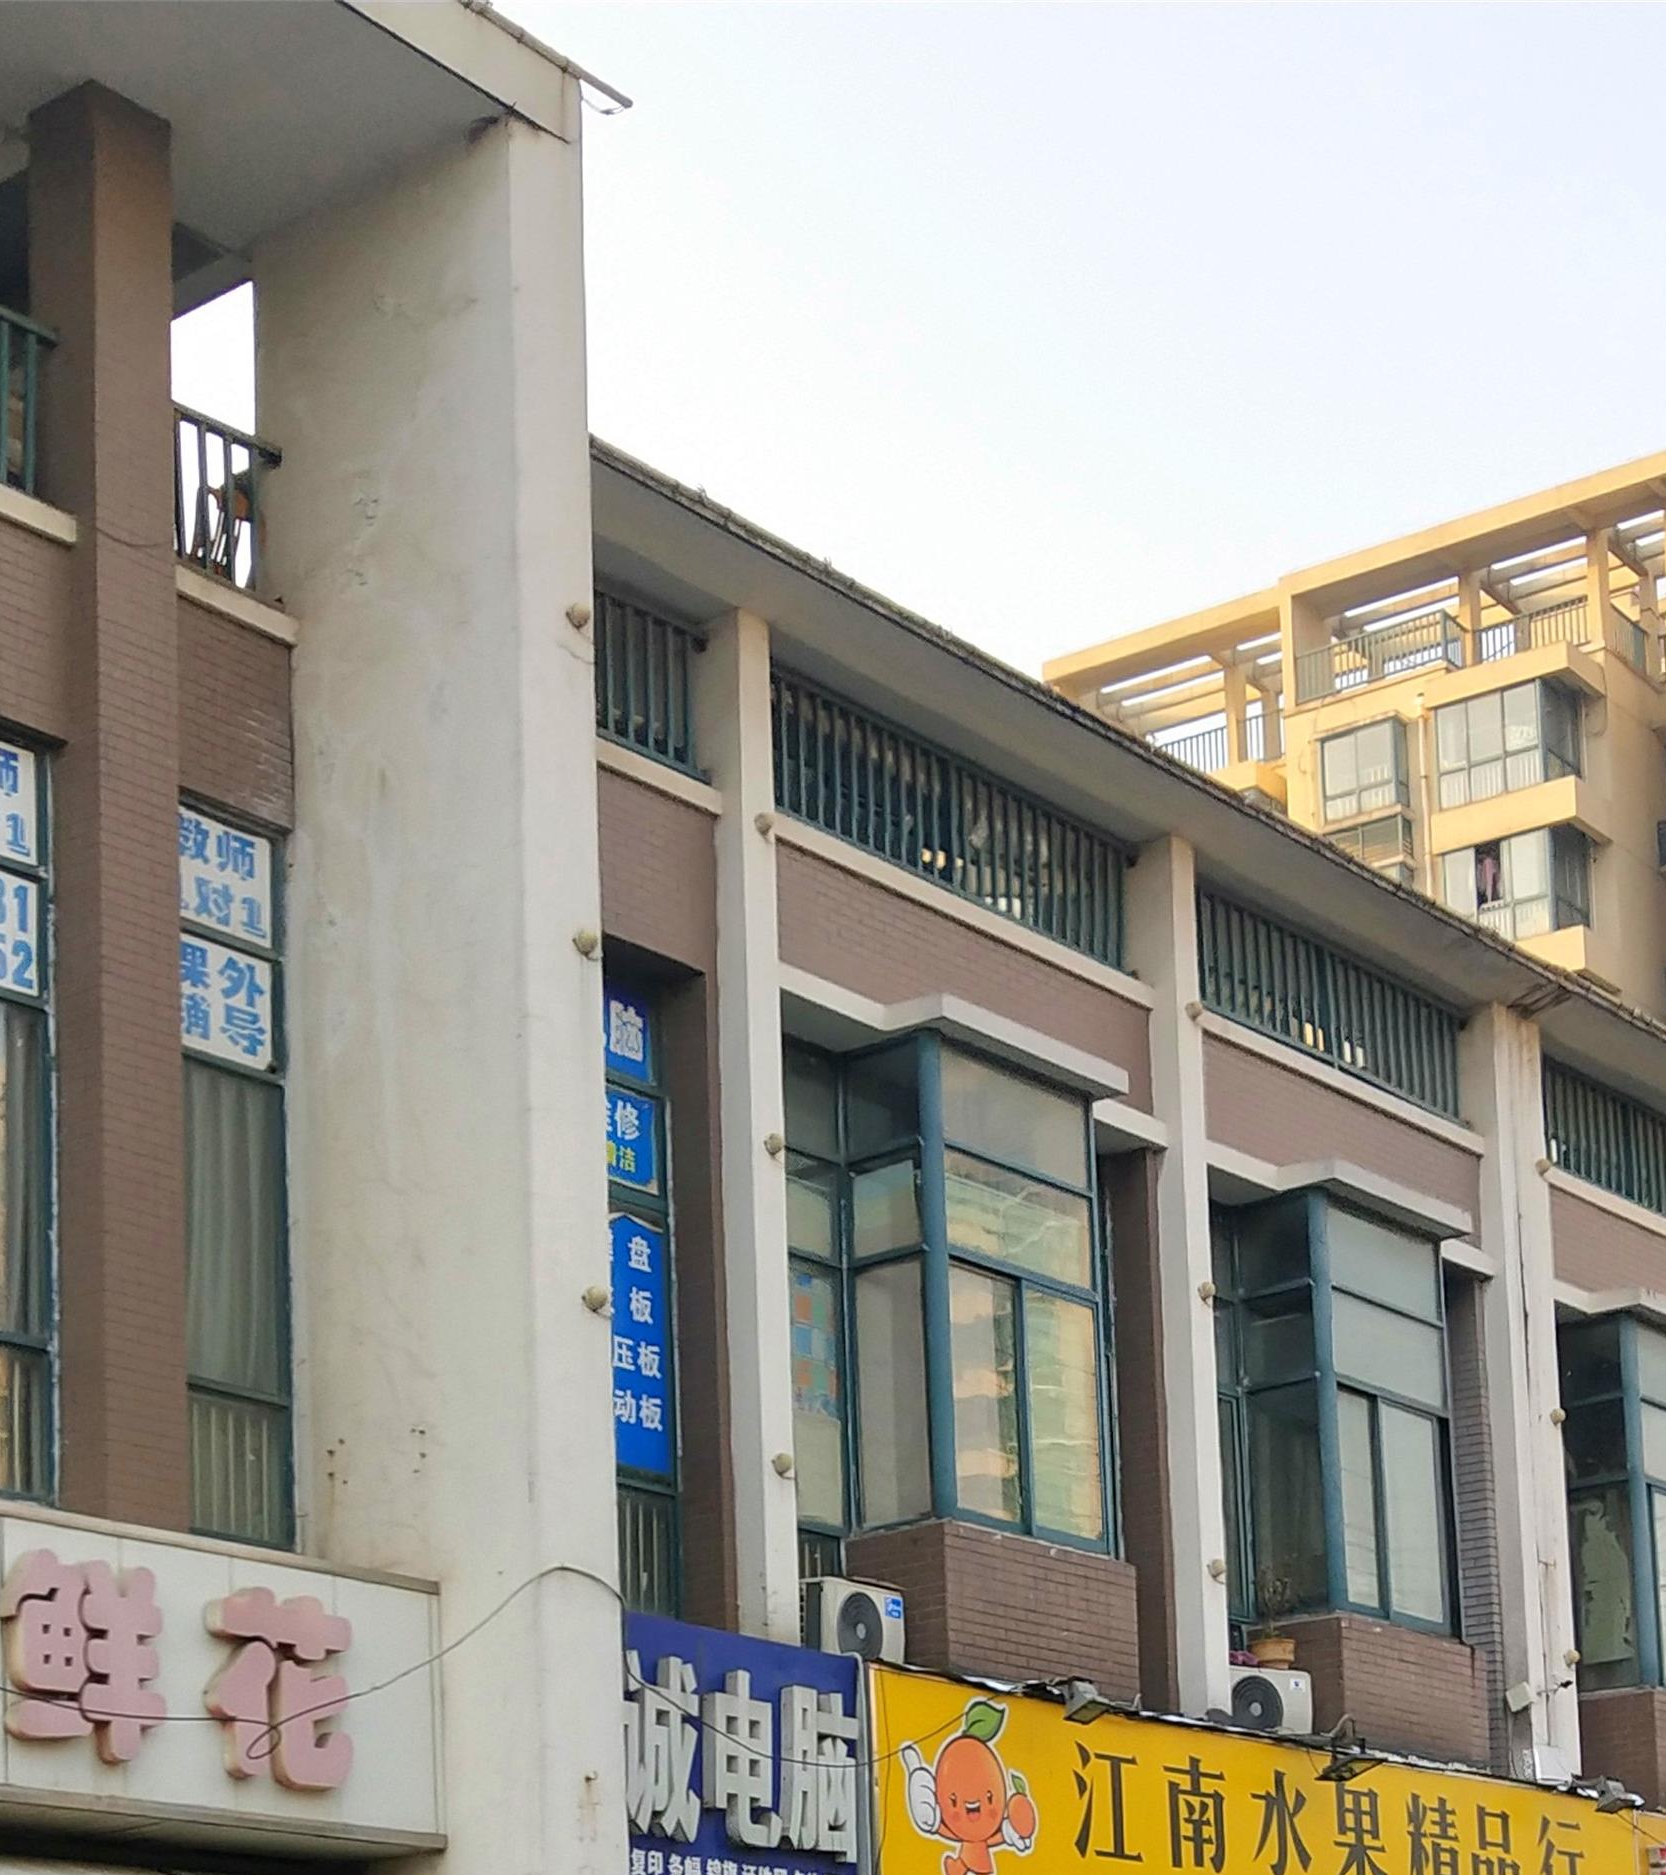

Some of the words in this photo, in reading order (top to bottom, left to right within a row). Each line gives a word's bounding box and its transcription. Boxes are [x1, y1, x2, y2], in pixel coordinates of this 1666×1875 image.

[179, 874, 267, 939] 对1
[604, 999, 644, 1062] 脑
[606, 1098, 641, 1141] 修
